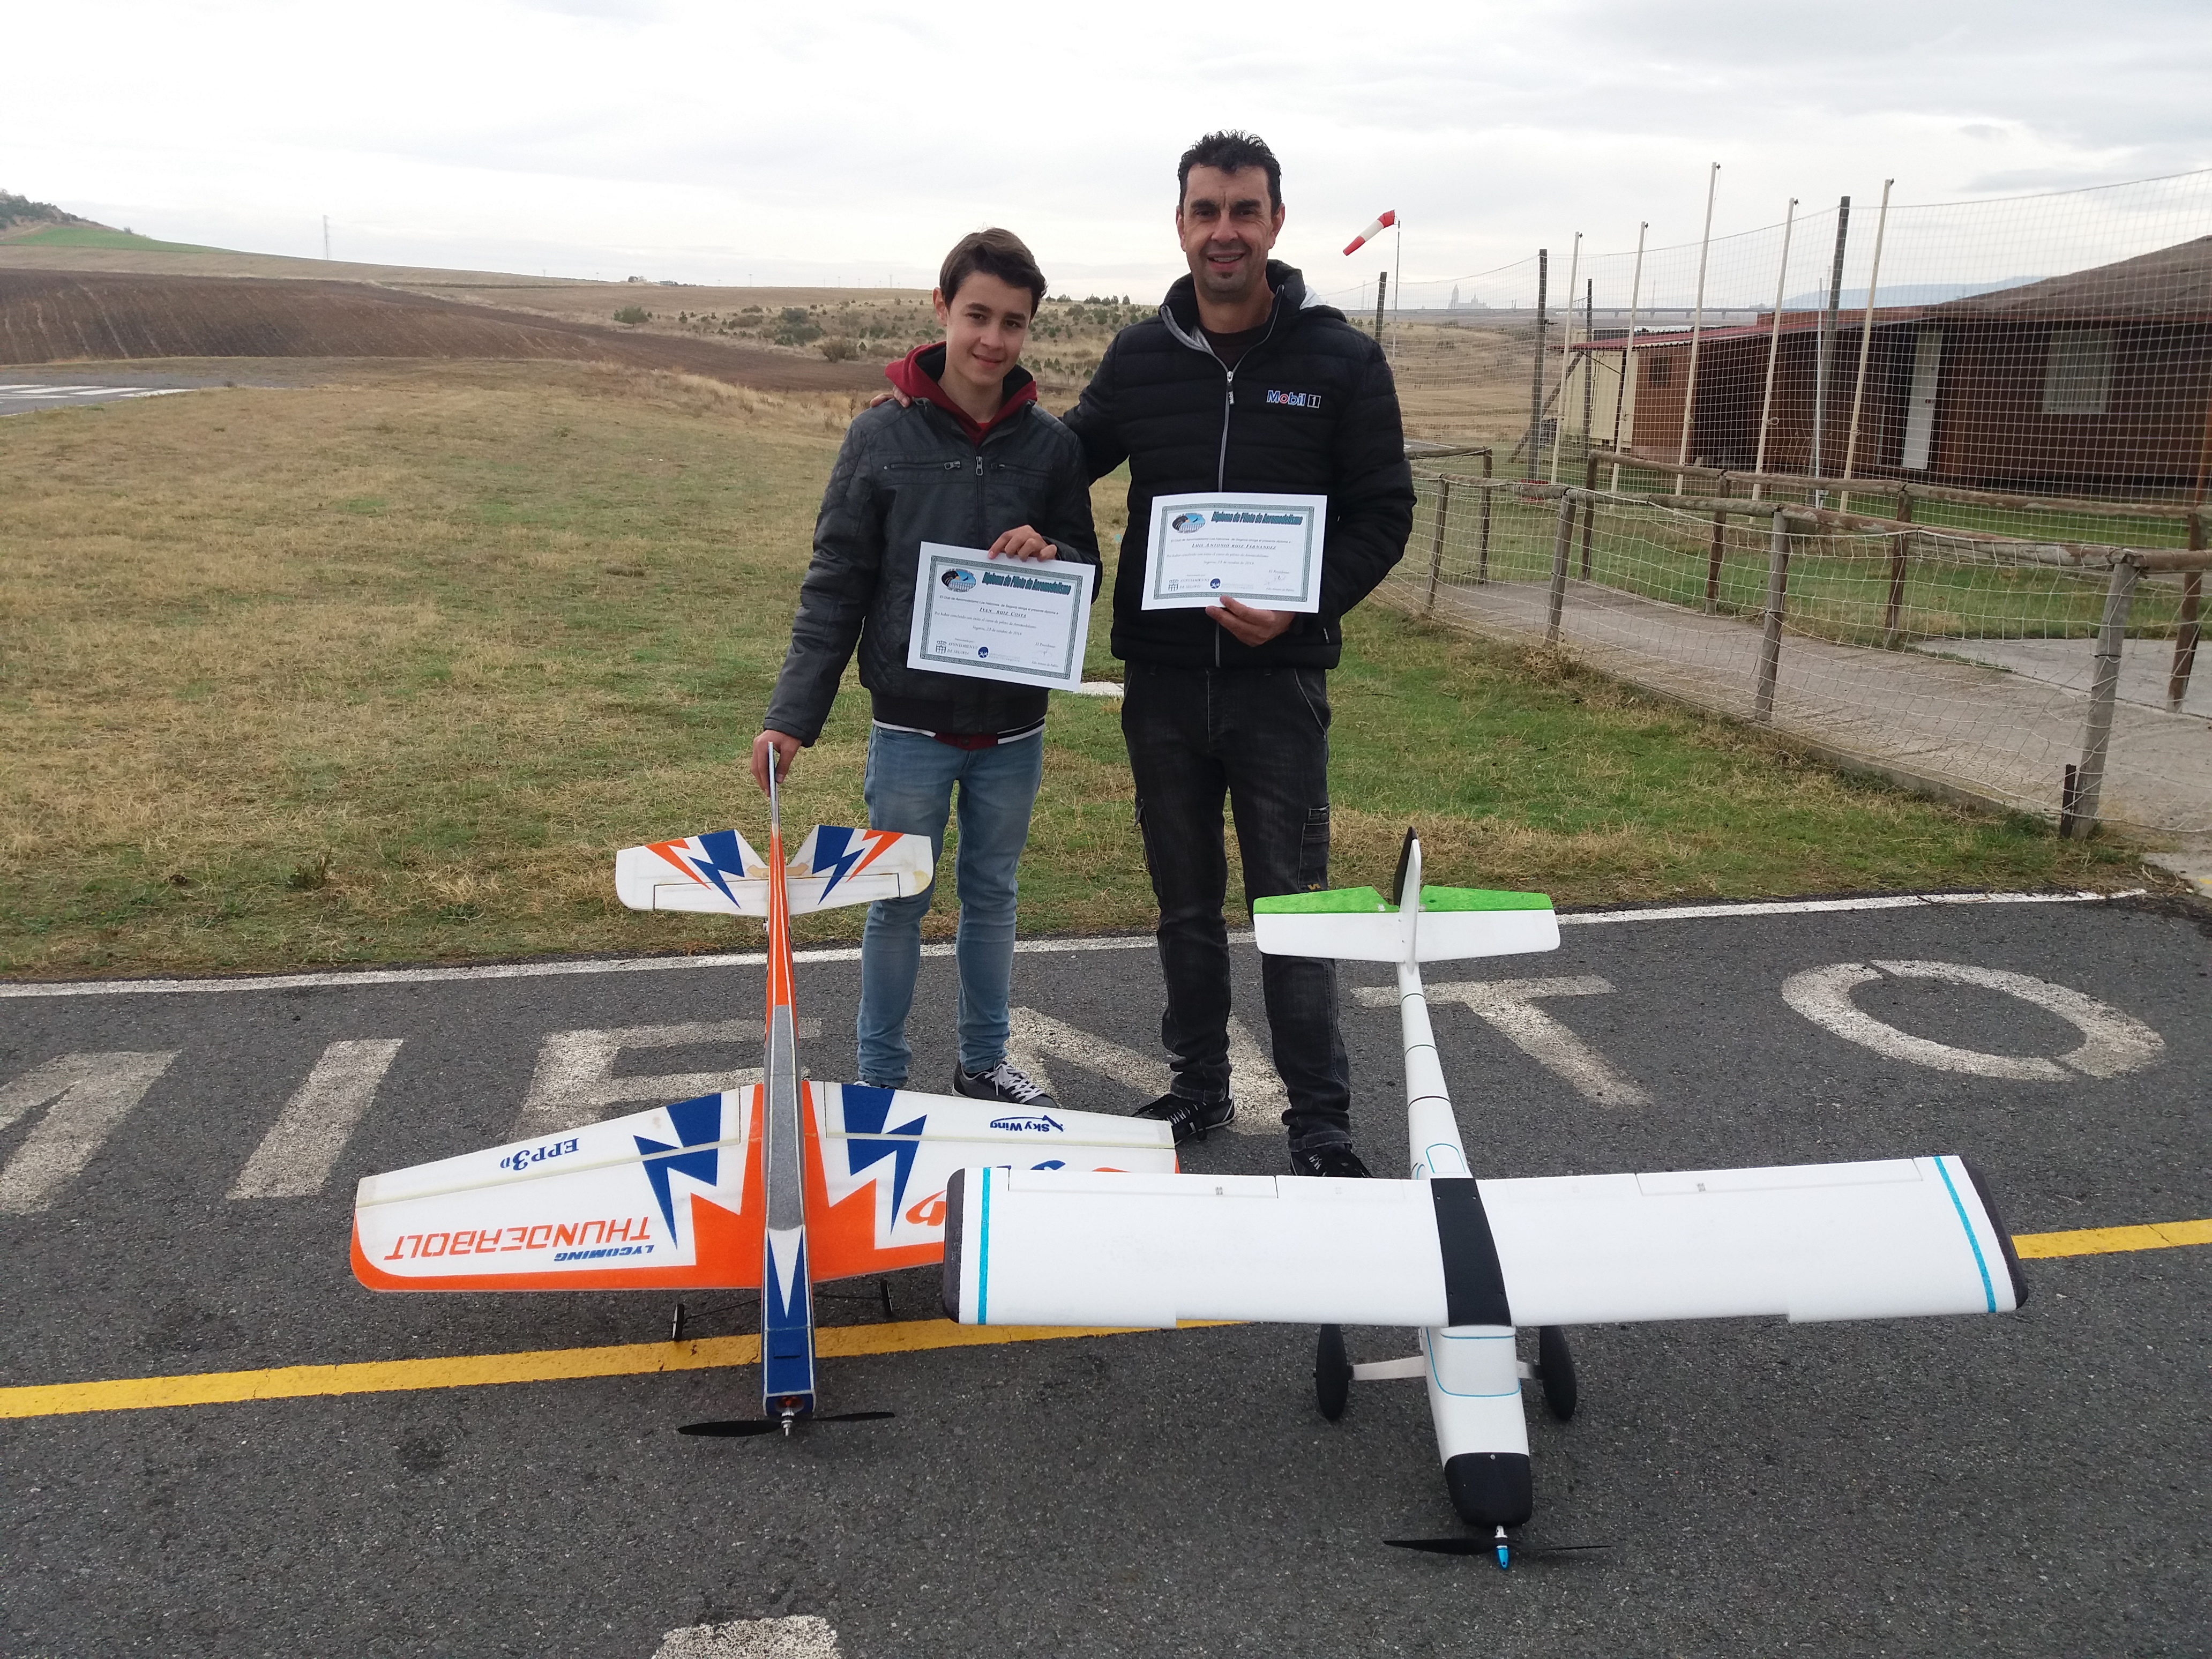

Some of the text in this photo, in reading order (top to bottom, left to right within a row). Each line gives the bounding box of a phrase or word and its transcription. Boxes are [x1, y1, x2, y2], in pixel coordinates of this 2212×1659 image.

[1266, 390, 1306, 406] Mobil
[1211, 511, 1234, 522] Diploma
[1232, 512, 1241, 522] de
[1239, 512, 1256, 524] Piloto
[1255, 513, 1263, 524] de
[1261, 513, 1303, 525] Aeromodelismo
[982, 571, 1005, 586] Diploma
[1003, 574, 1012, 587] de
[1010, 576, 1026, 589] Piloto
[1025, 578, 1033, 590] de
[1032, 579, 1072, 595] Aeromodelismo
[1024, 1121, 1050, 1132] Sky
[384, 1216, 651, 1260] THUNDERBOLT
[554, 1244, 654, 1261] LYCOMING
